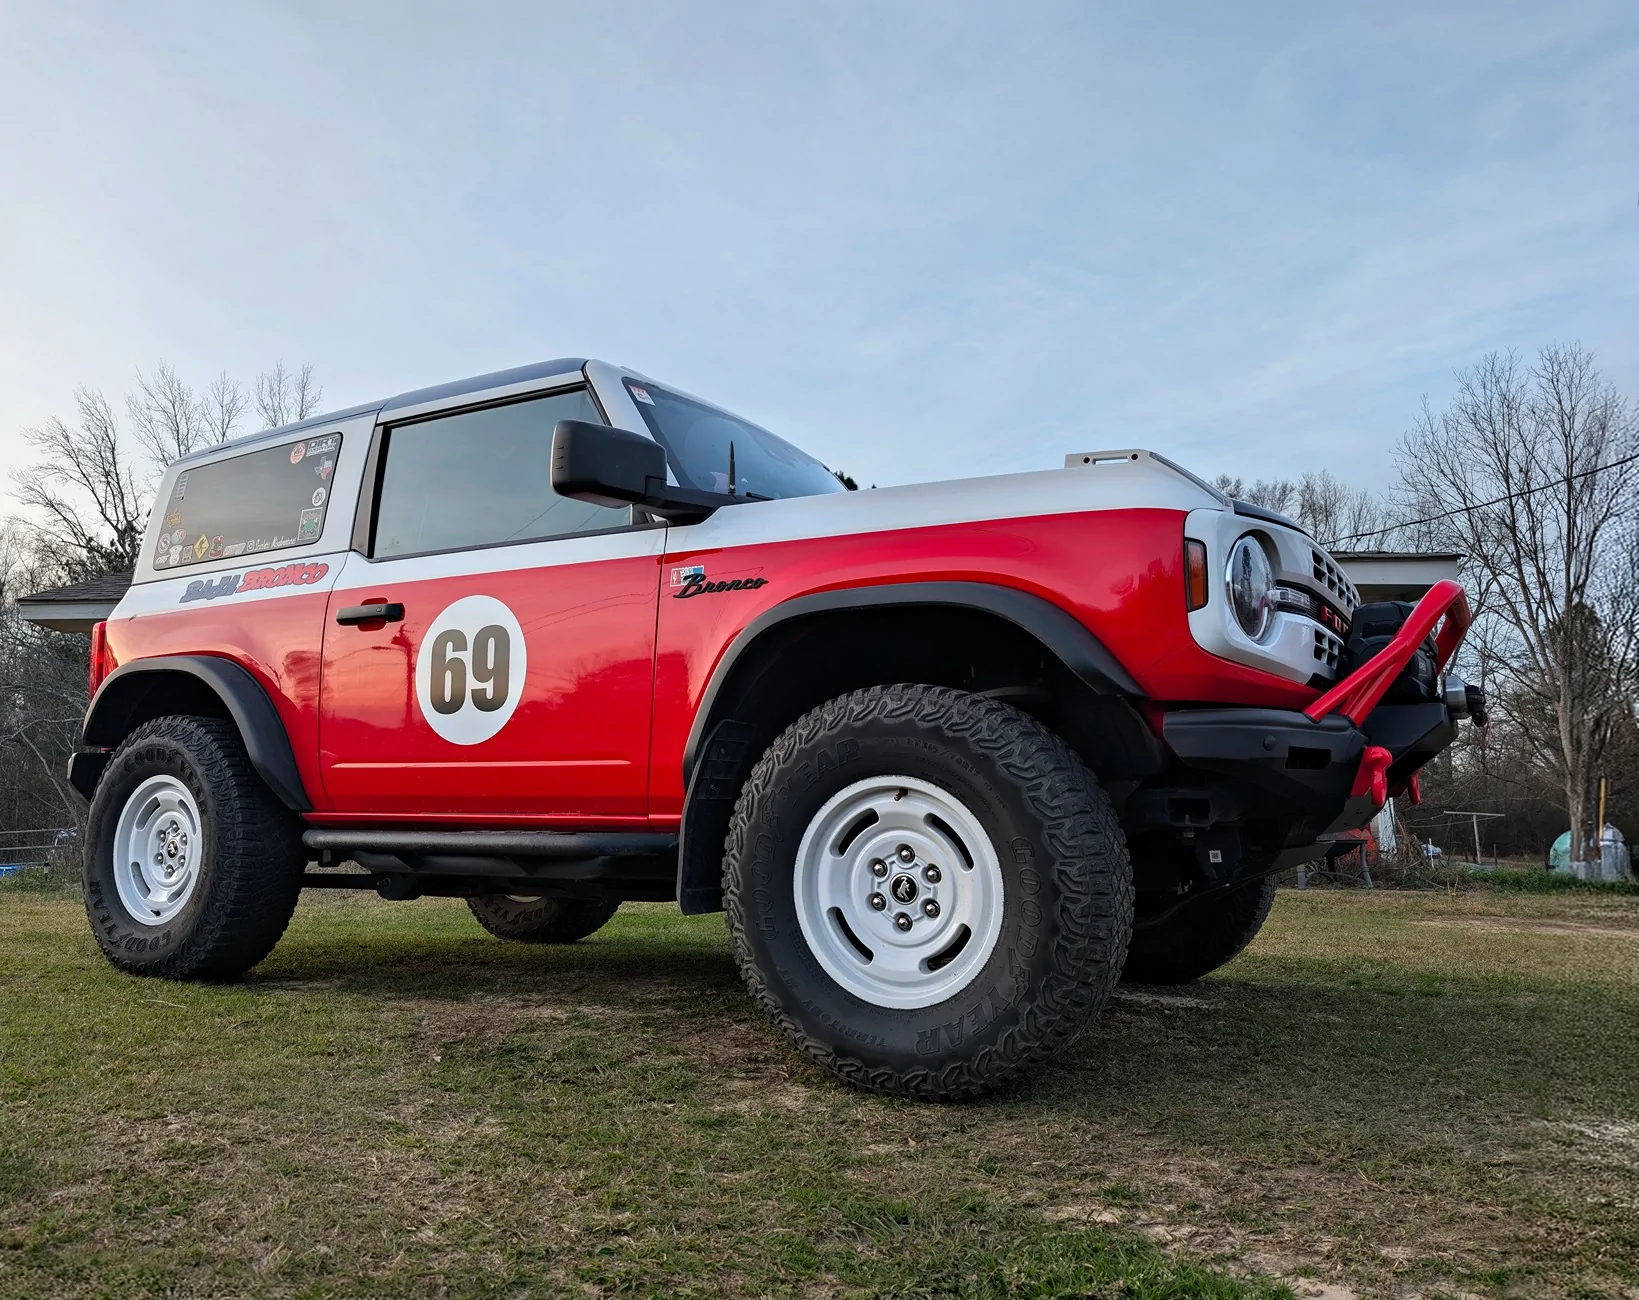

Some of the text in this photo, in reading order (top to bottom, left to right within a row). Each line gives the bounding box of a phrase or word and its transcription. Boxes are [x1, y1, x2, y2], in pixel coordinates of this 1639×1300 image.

[309, 435, 338, 449] DIRT
[179, 563, 329, 603] BAJA BRONCO
[673, 573, 769, 598] Bronco
[430, 624, 511, 715] 69
